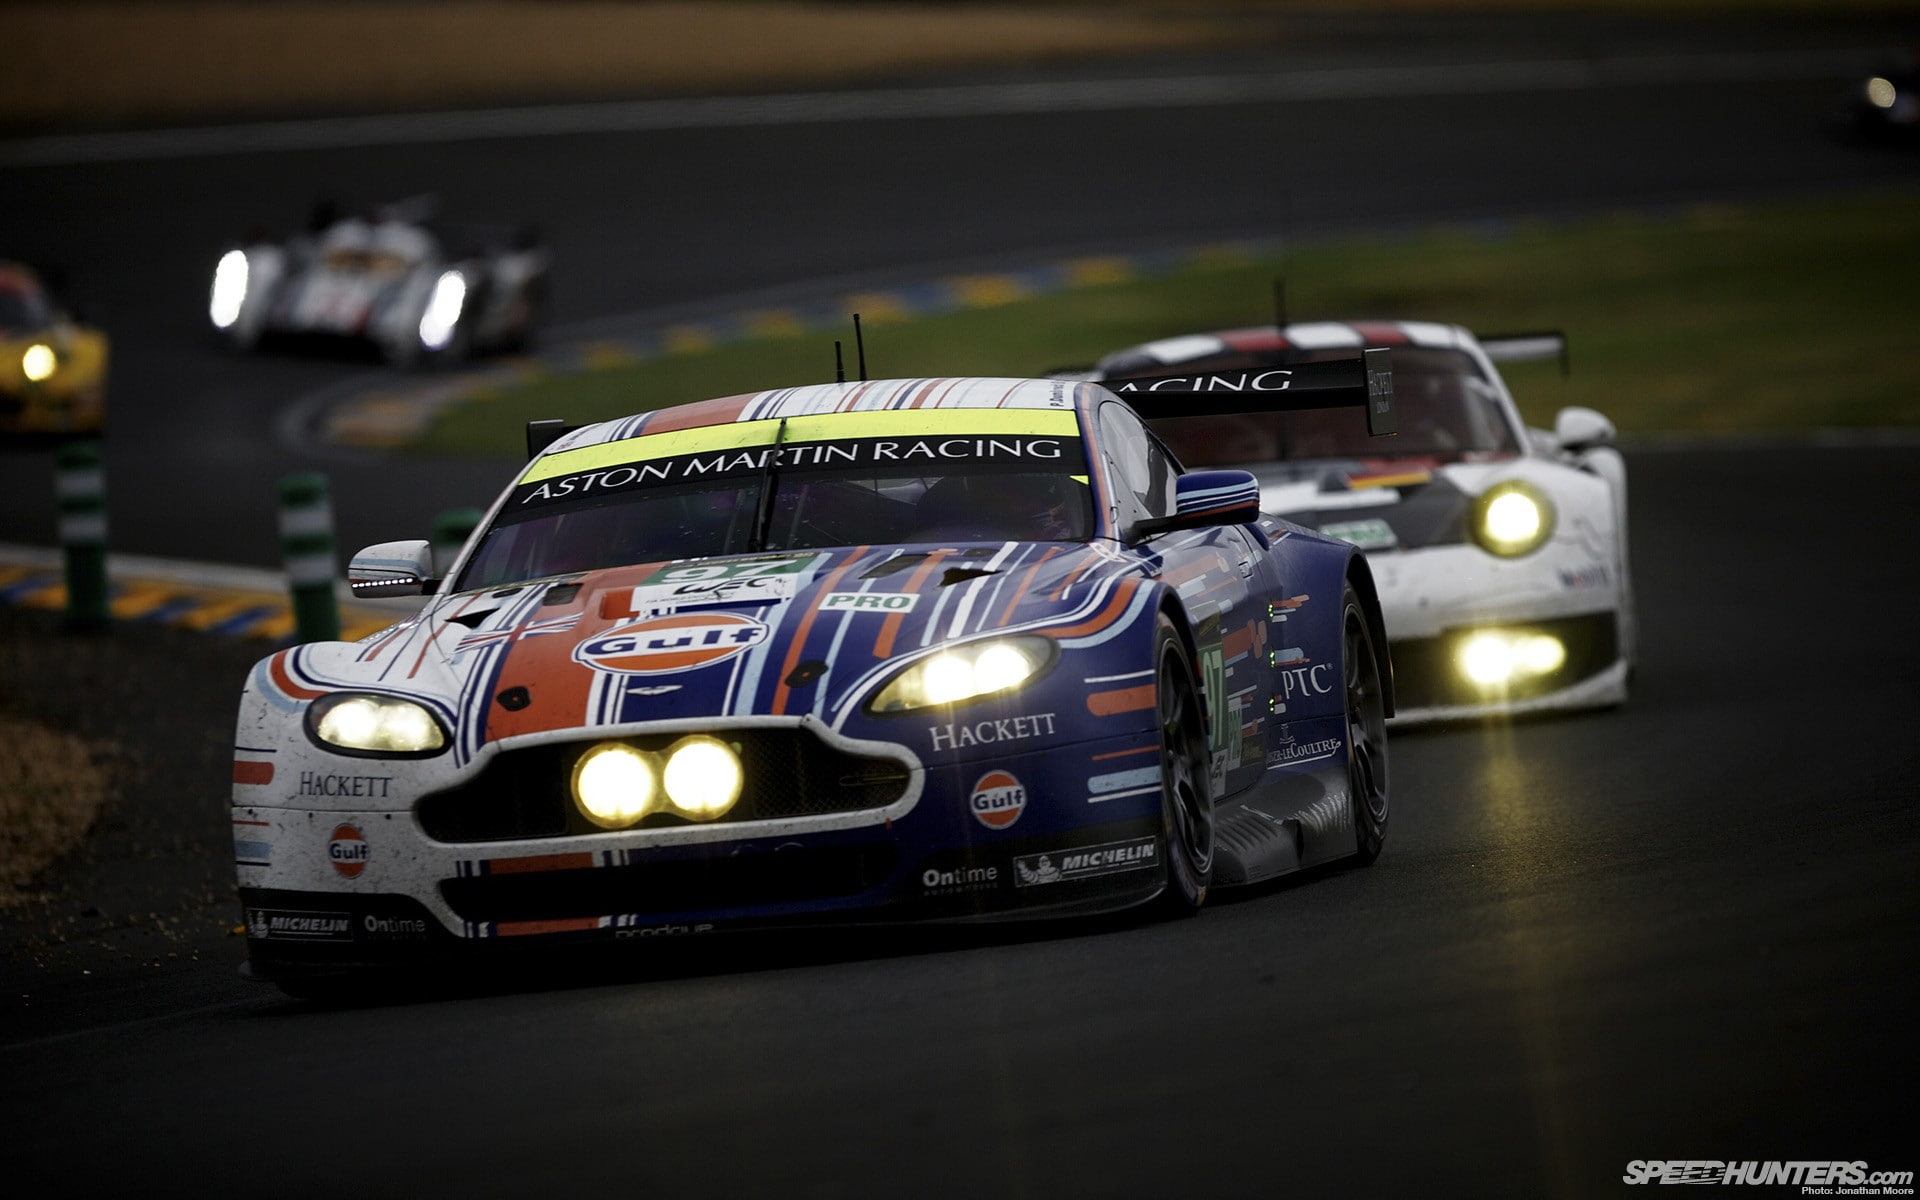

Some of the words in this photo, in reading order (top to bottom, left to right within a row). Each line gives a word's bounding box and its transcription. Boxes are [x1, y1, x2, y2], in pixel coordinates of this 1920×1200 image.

[522, 461, 673, 504] ASTON
[682, 444, 857, 477] MARTIN
[873, 439, 1061, 460] RACING
[661, 559, 798, 584] 97
[673, 576, 776, 595] WEC
[826, 594, 911, 611] PRO
[583, 625, 764, 655] Gulf
[929, 713, 1056, 751] HACKETT
[300, 771, 393, 798] HACKETT
[972, 789, 1024, 811] Gulf
[330, 843, 369, 860] Gulf
[1062, 844, 1155, 871] MICHELIN
[922, 866, 998, 887] Ontime
[270, 916, 349, 932] MICHELIN
[364, 914, 426, 933] Ontime
